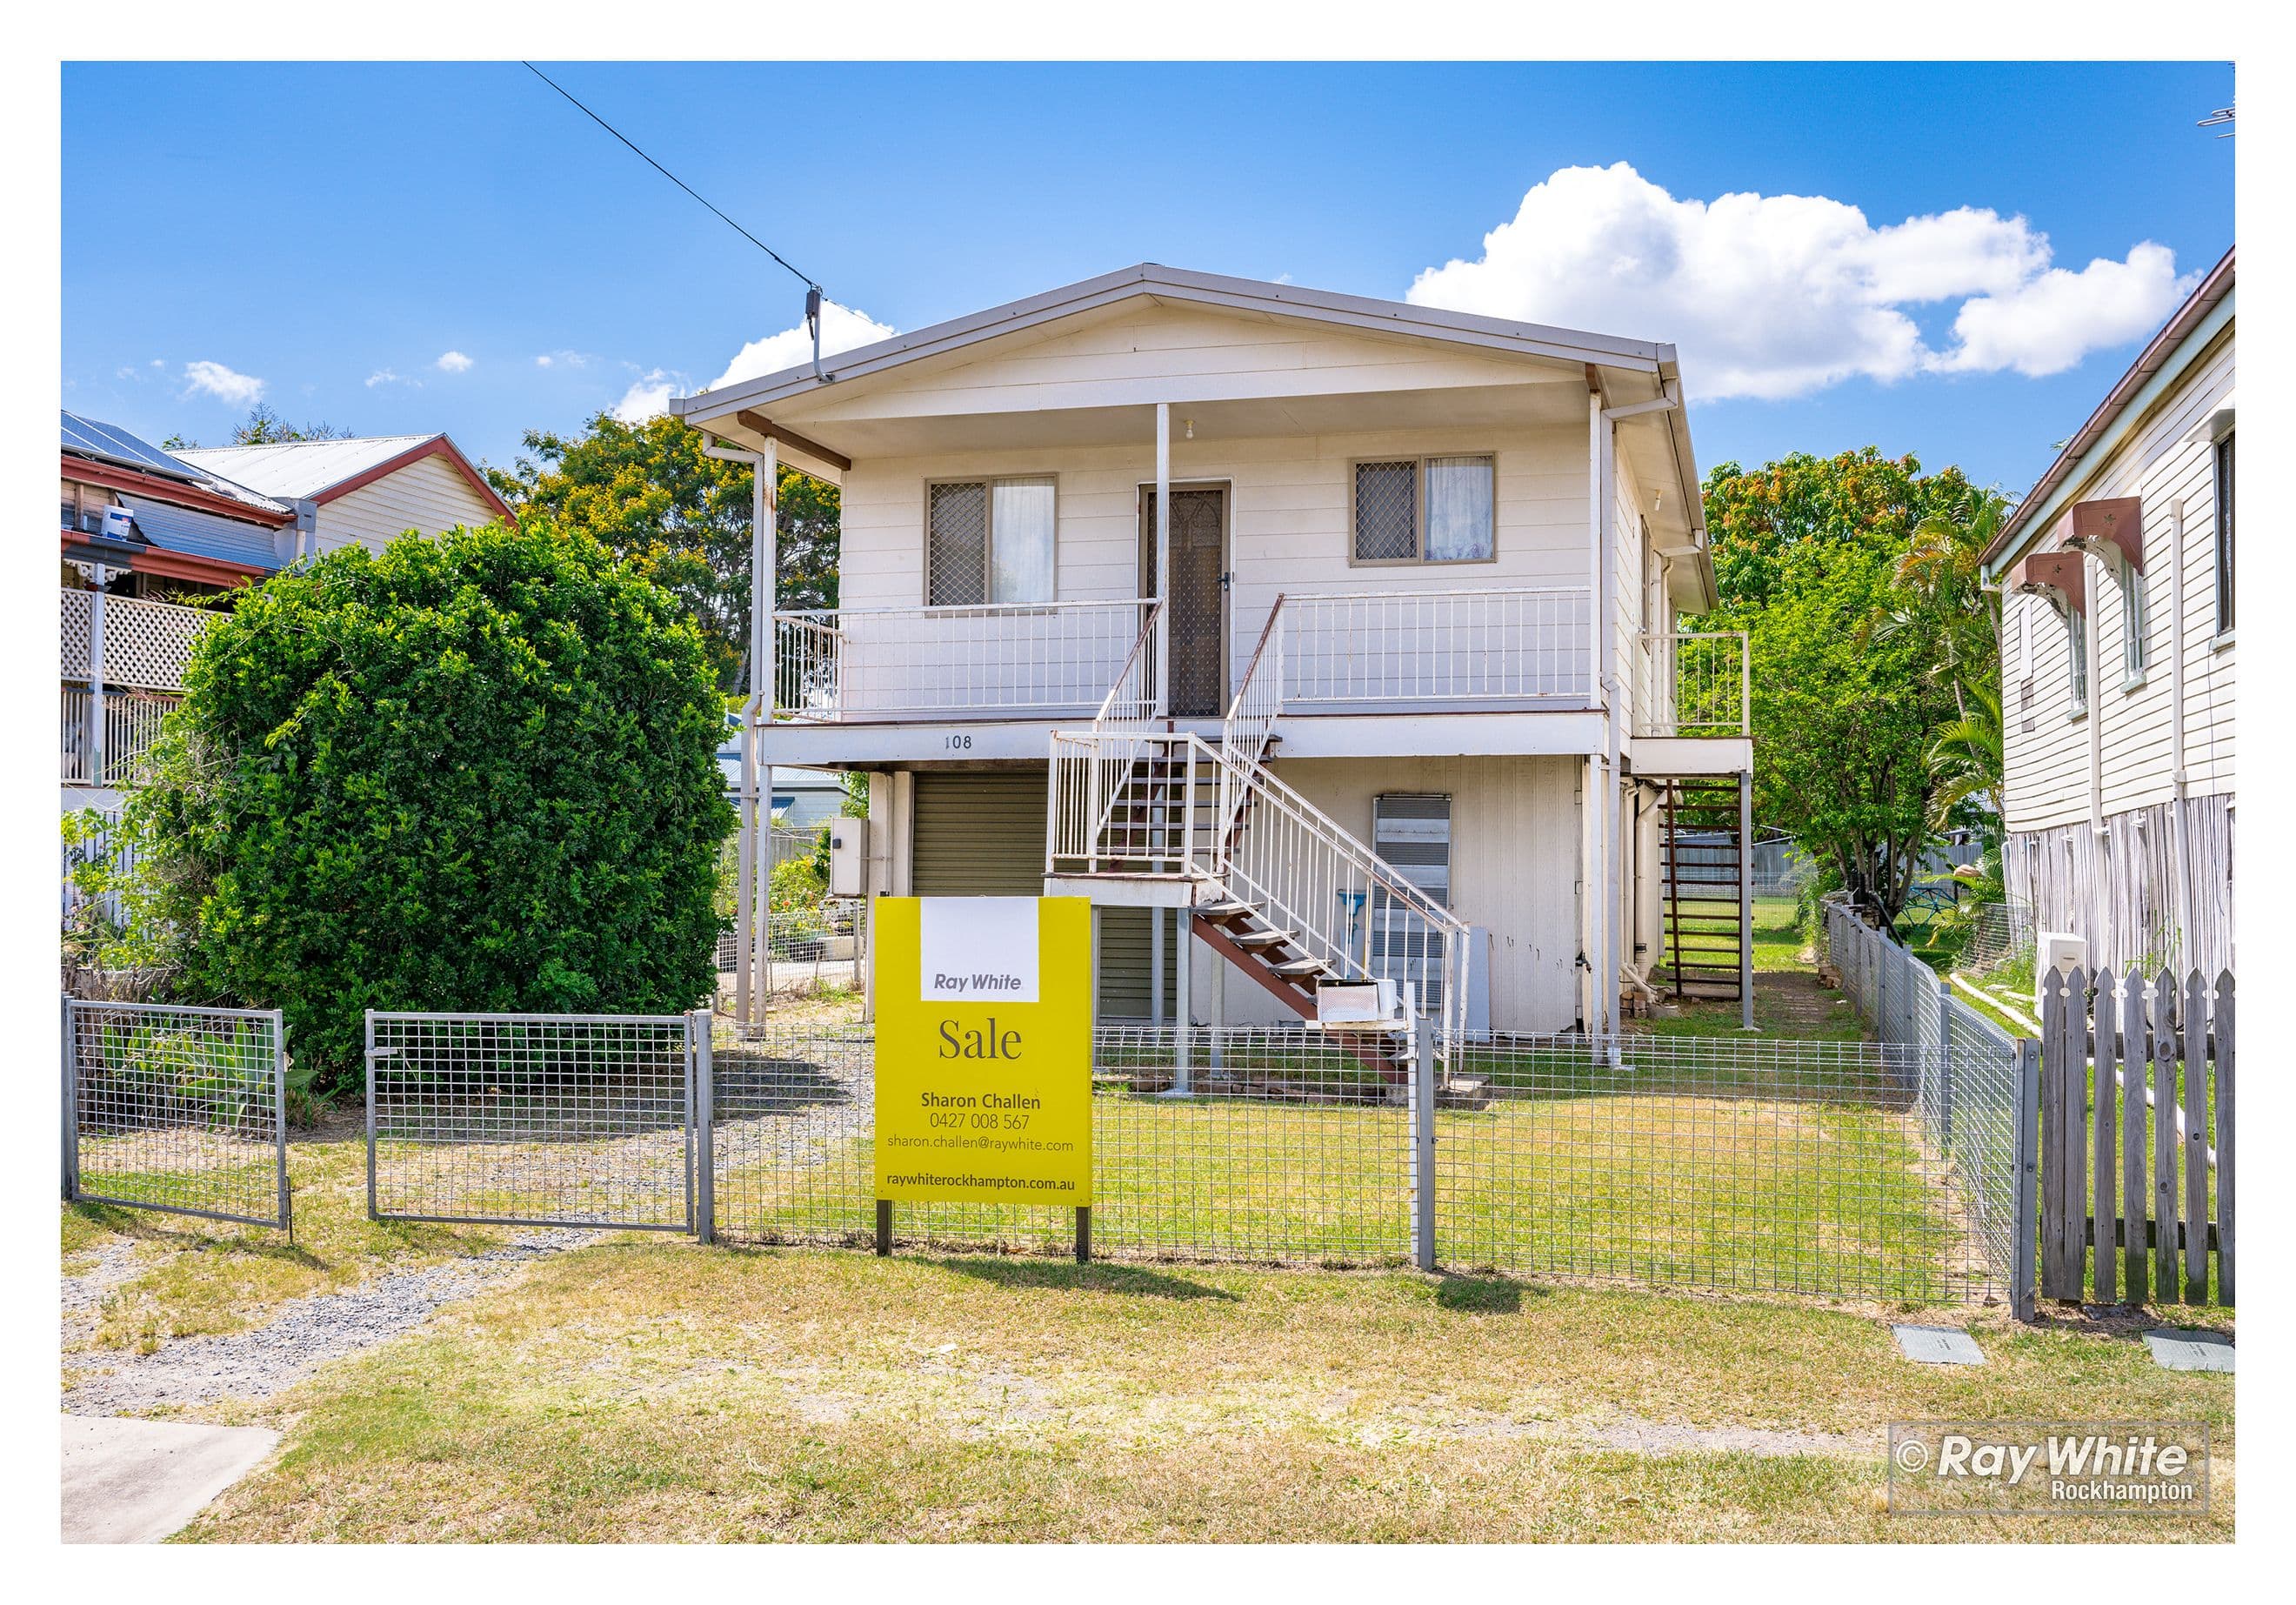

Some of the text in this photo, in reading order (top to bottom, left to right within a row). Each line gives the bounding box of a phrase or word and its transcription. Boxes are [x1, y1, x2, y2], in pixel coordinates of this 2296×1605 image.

[945, 735, 972, 750] 108
[934, 973, 1022, 993] Ray White
[939, 1018, 1022, 1060] Sale
[921, 1092, 1041, 1110] Sharon Challen
[930, 1113, 1030, 1130] 0427 008 567
[887, 1134, 1074, 1154] sharon.challen@raywhite.com
[886, 1173, 1075, 1193] raywhiterockhampton.com.au
